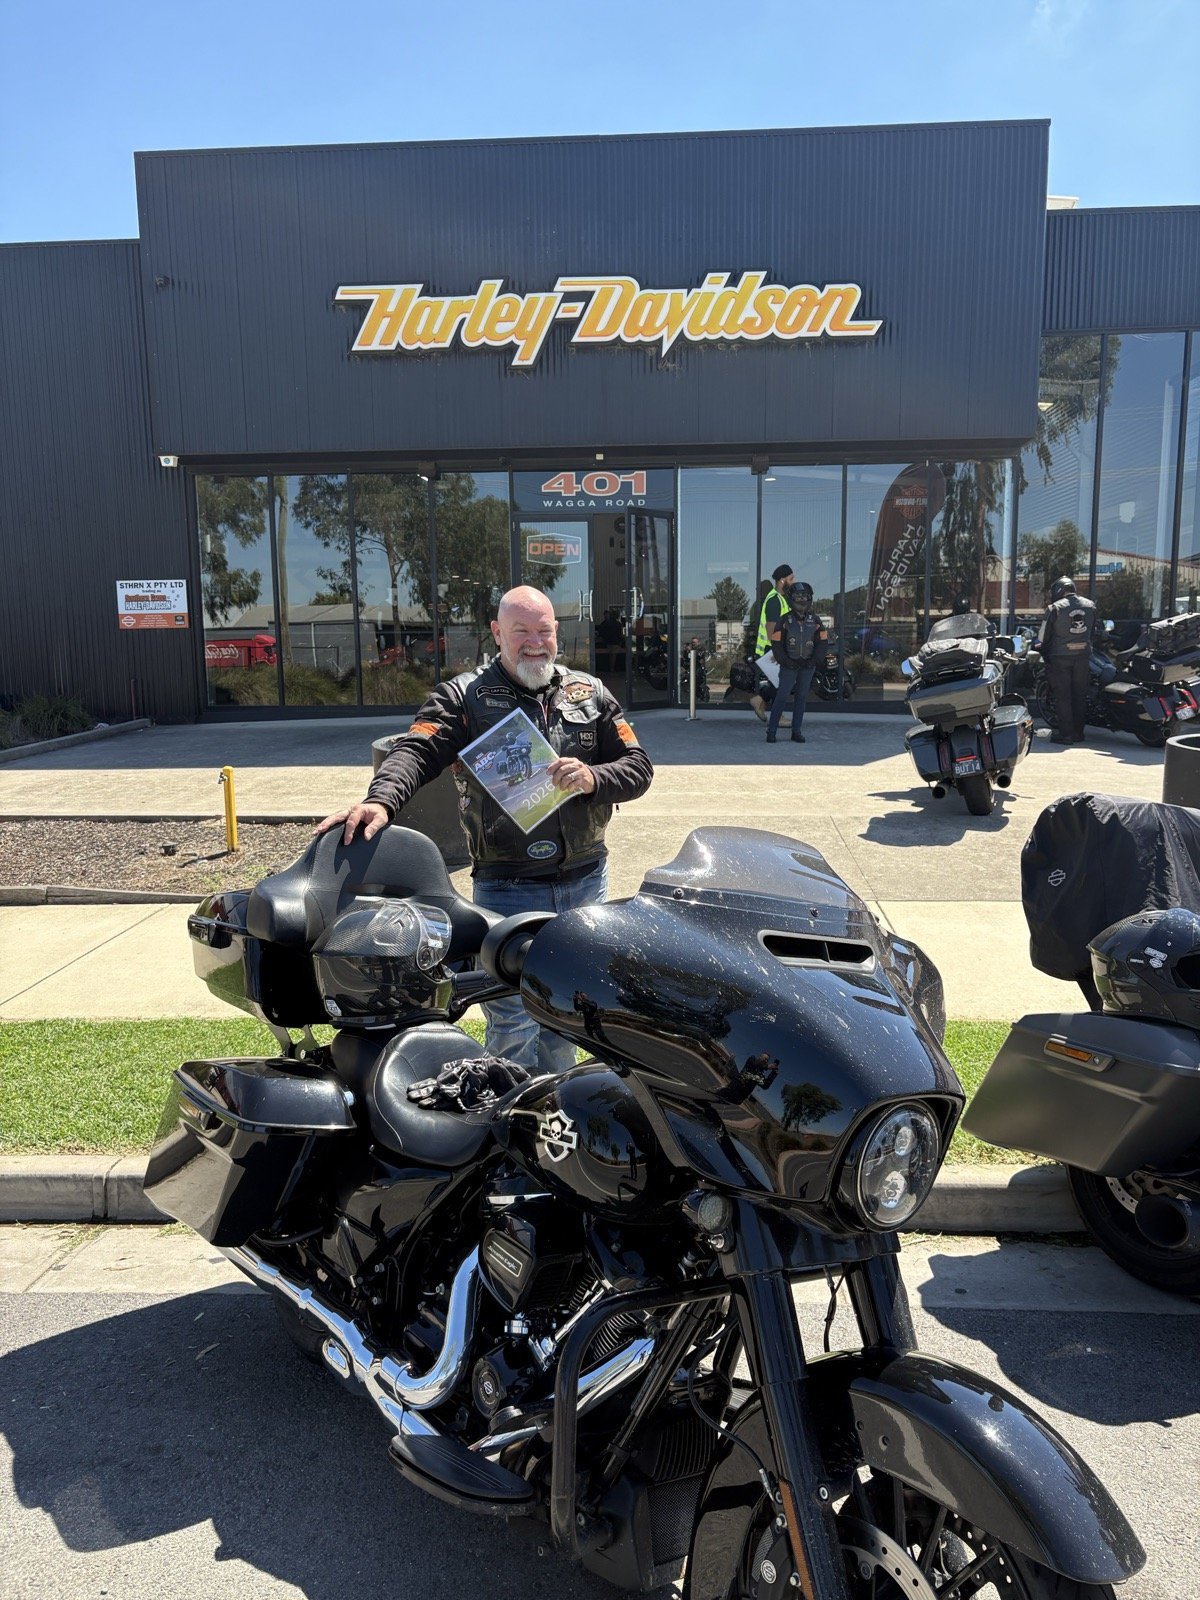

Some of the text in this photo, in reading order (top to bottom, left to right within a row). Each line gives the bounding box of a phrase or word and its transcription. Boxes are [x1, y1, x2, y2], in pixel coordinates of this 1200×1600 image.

[335, 270, 883, 366] Harley-Davidson
[541, 470, 647, 497] 401
[529, 543, 580, 556] OPEN
[522, 777, 556, 811] 2026
